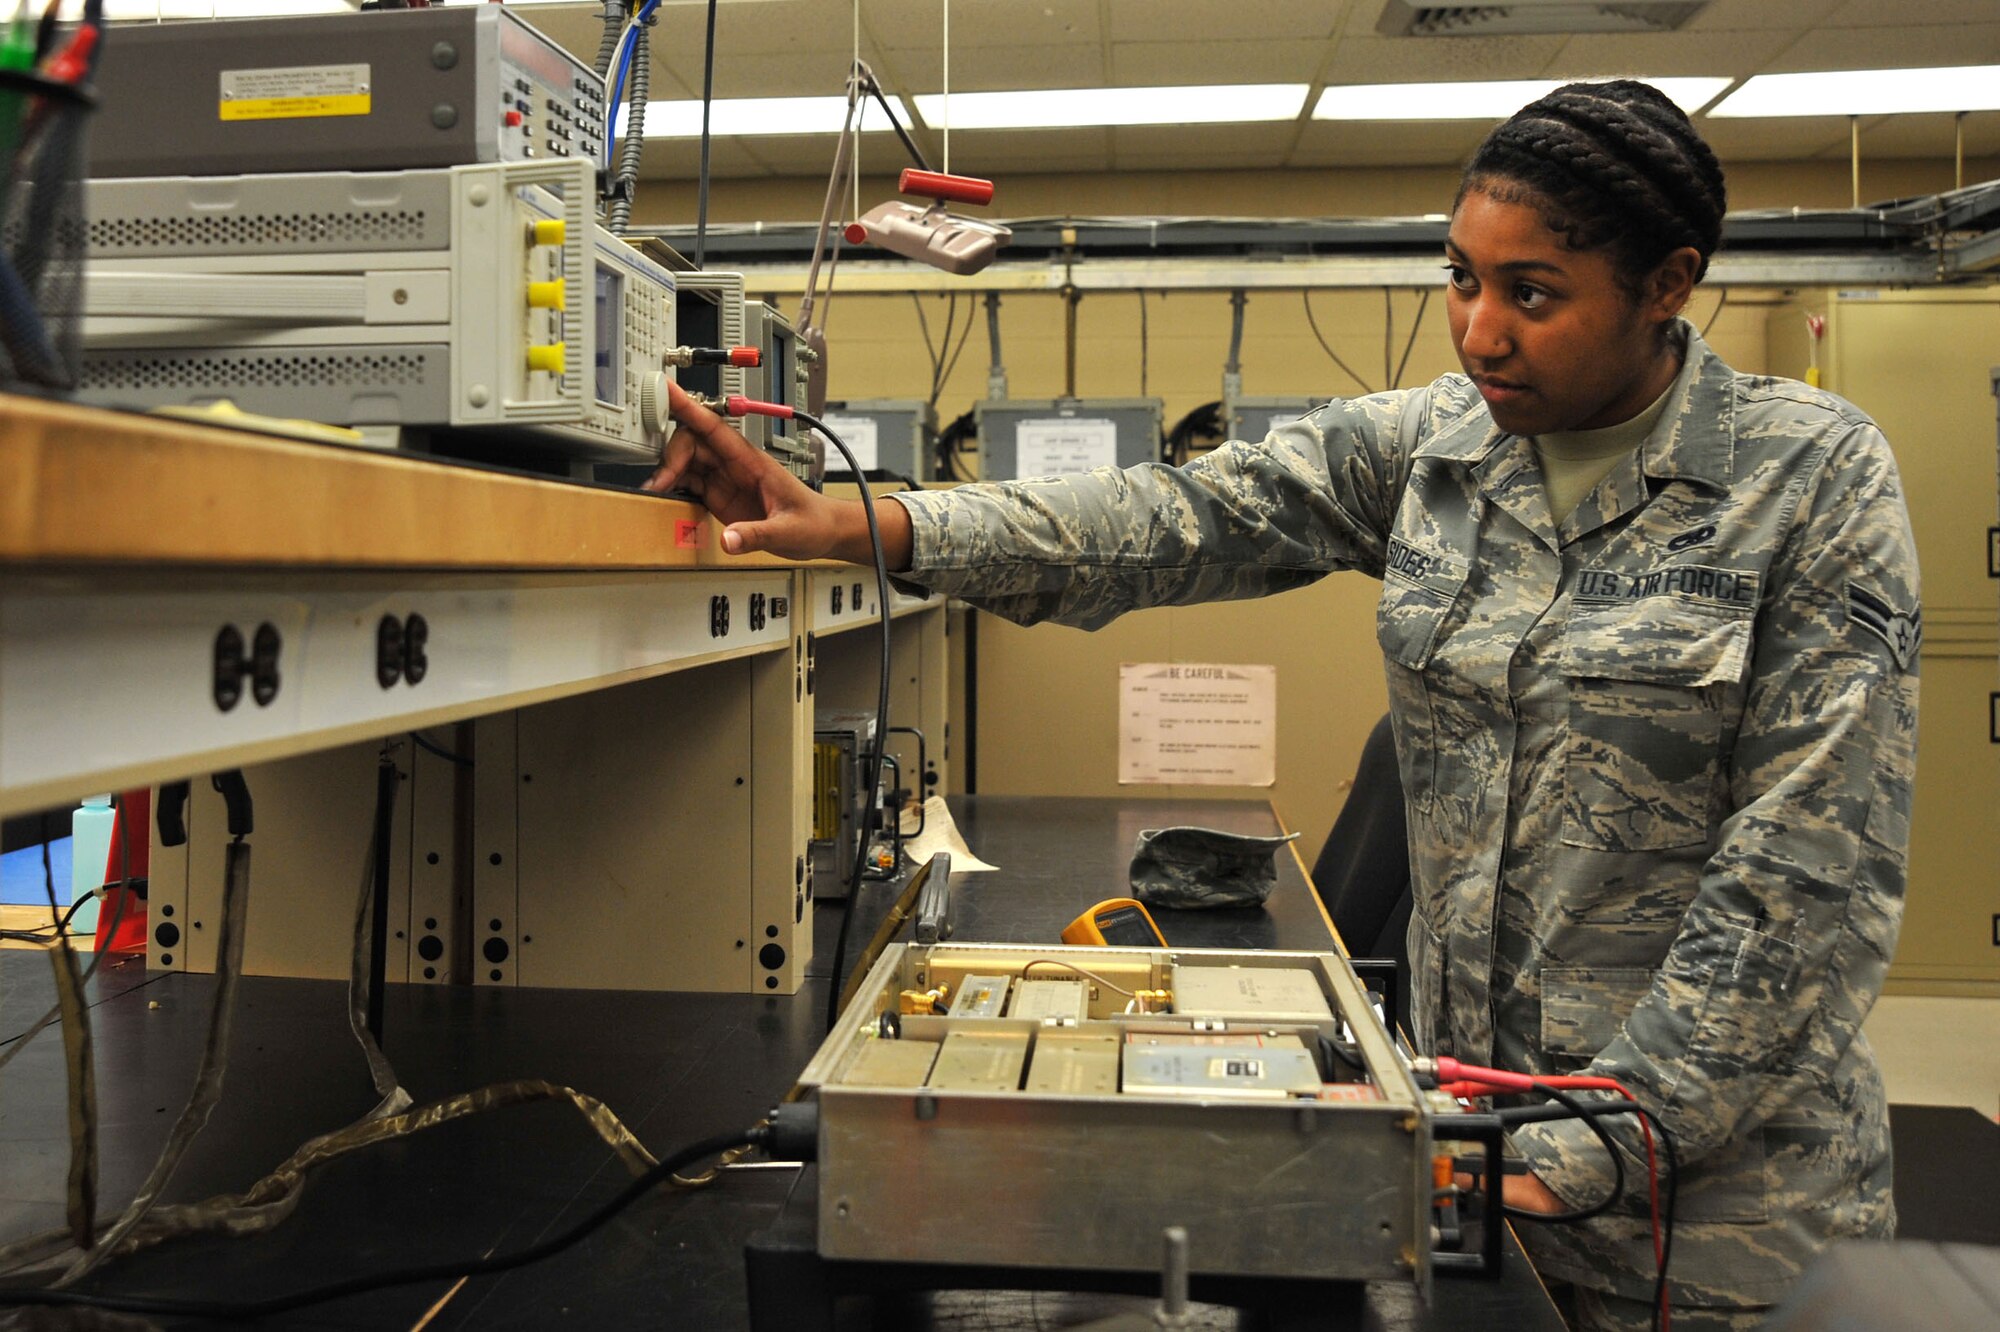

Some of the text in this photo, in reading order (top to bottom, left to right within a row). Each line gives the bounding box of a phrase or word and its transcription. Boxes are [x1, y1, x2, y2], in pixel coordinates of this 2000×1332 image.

[1387, 541, 1431, 579] SIDES
[1579, 568, 1752, 600] U.S. AIR FORCE
[1169, 668, 1225, 679] BE CAREFUL
